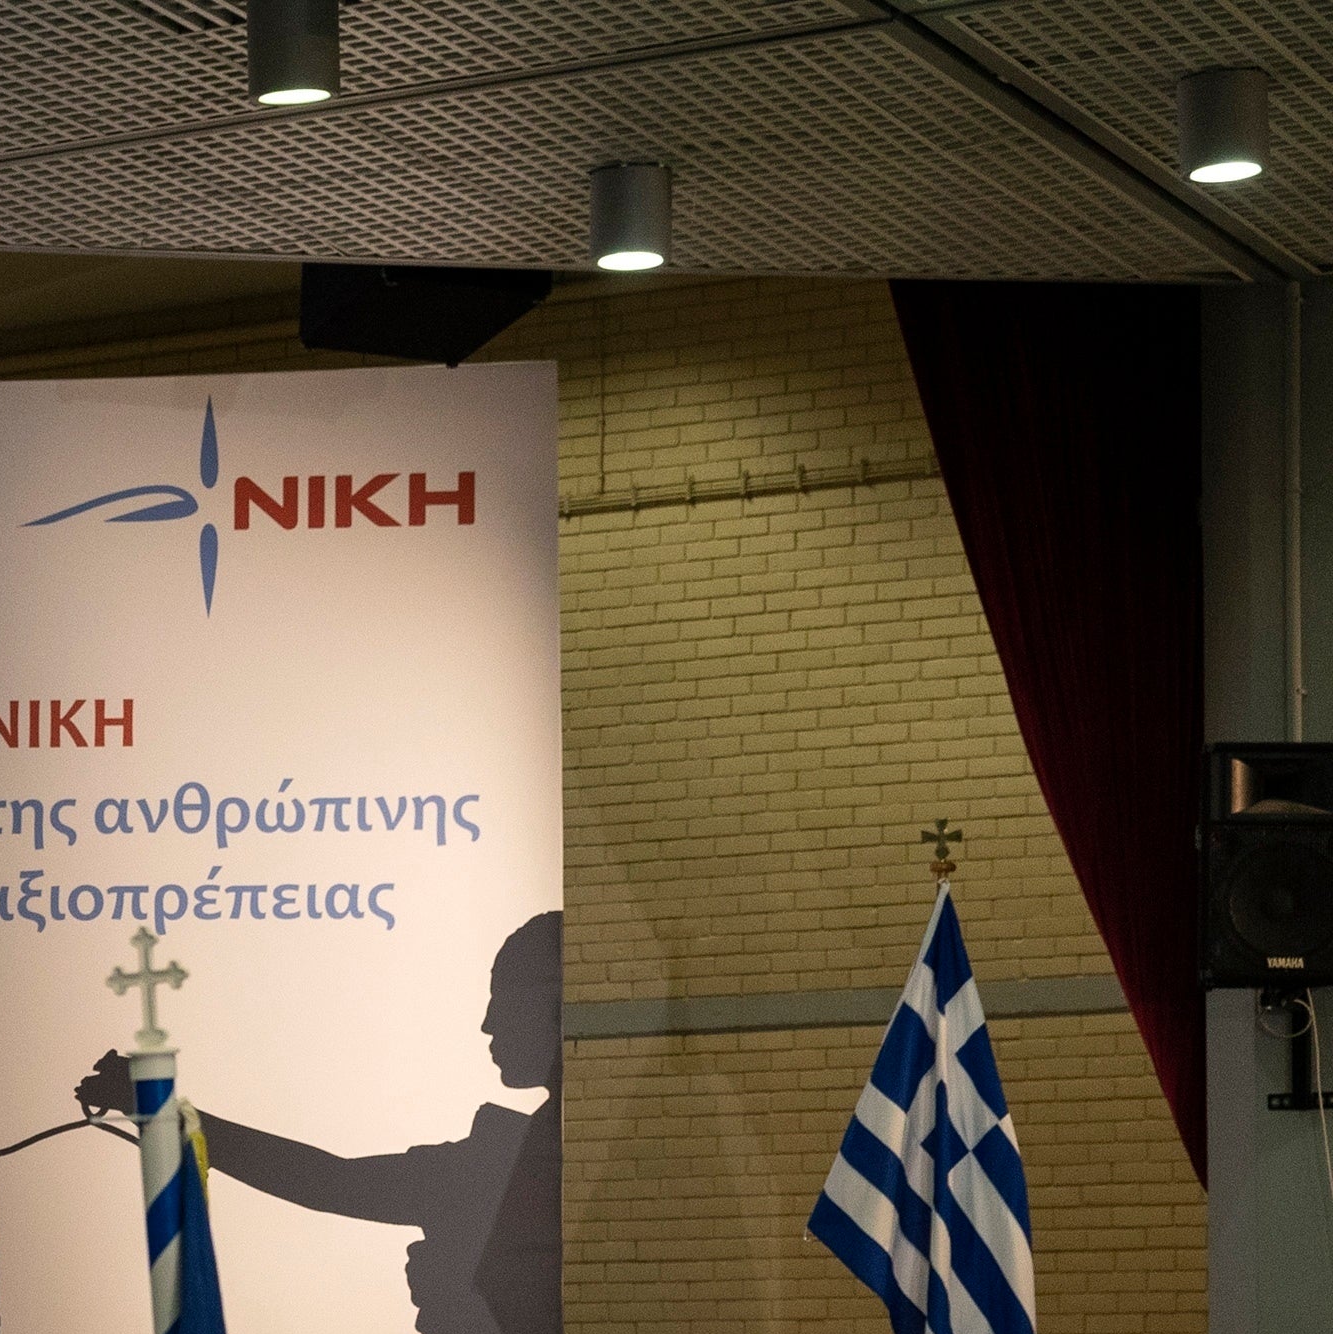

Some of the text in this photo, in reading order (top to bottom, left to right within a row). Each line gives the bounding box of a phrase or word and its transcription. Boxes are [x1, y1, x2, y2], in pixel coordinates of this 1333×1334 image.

[233, 471, 476, 530] ΝΙΚΗ
[94, 778, 481, 850] ανθρώπινης
[1266, 957, 1304, 969] YAMAHA
